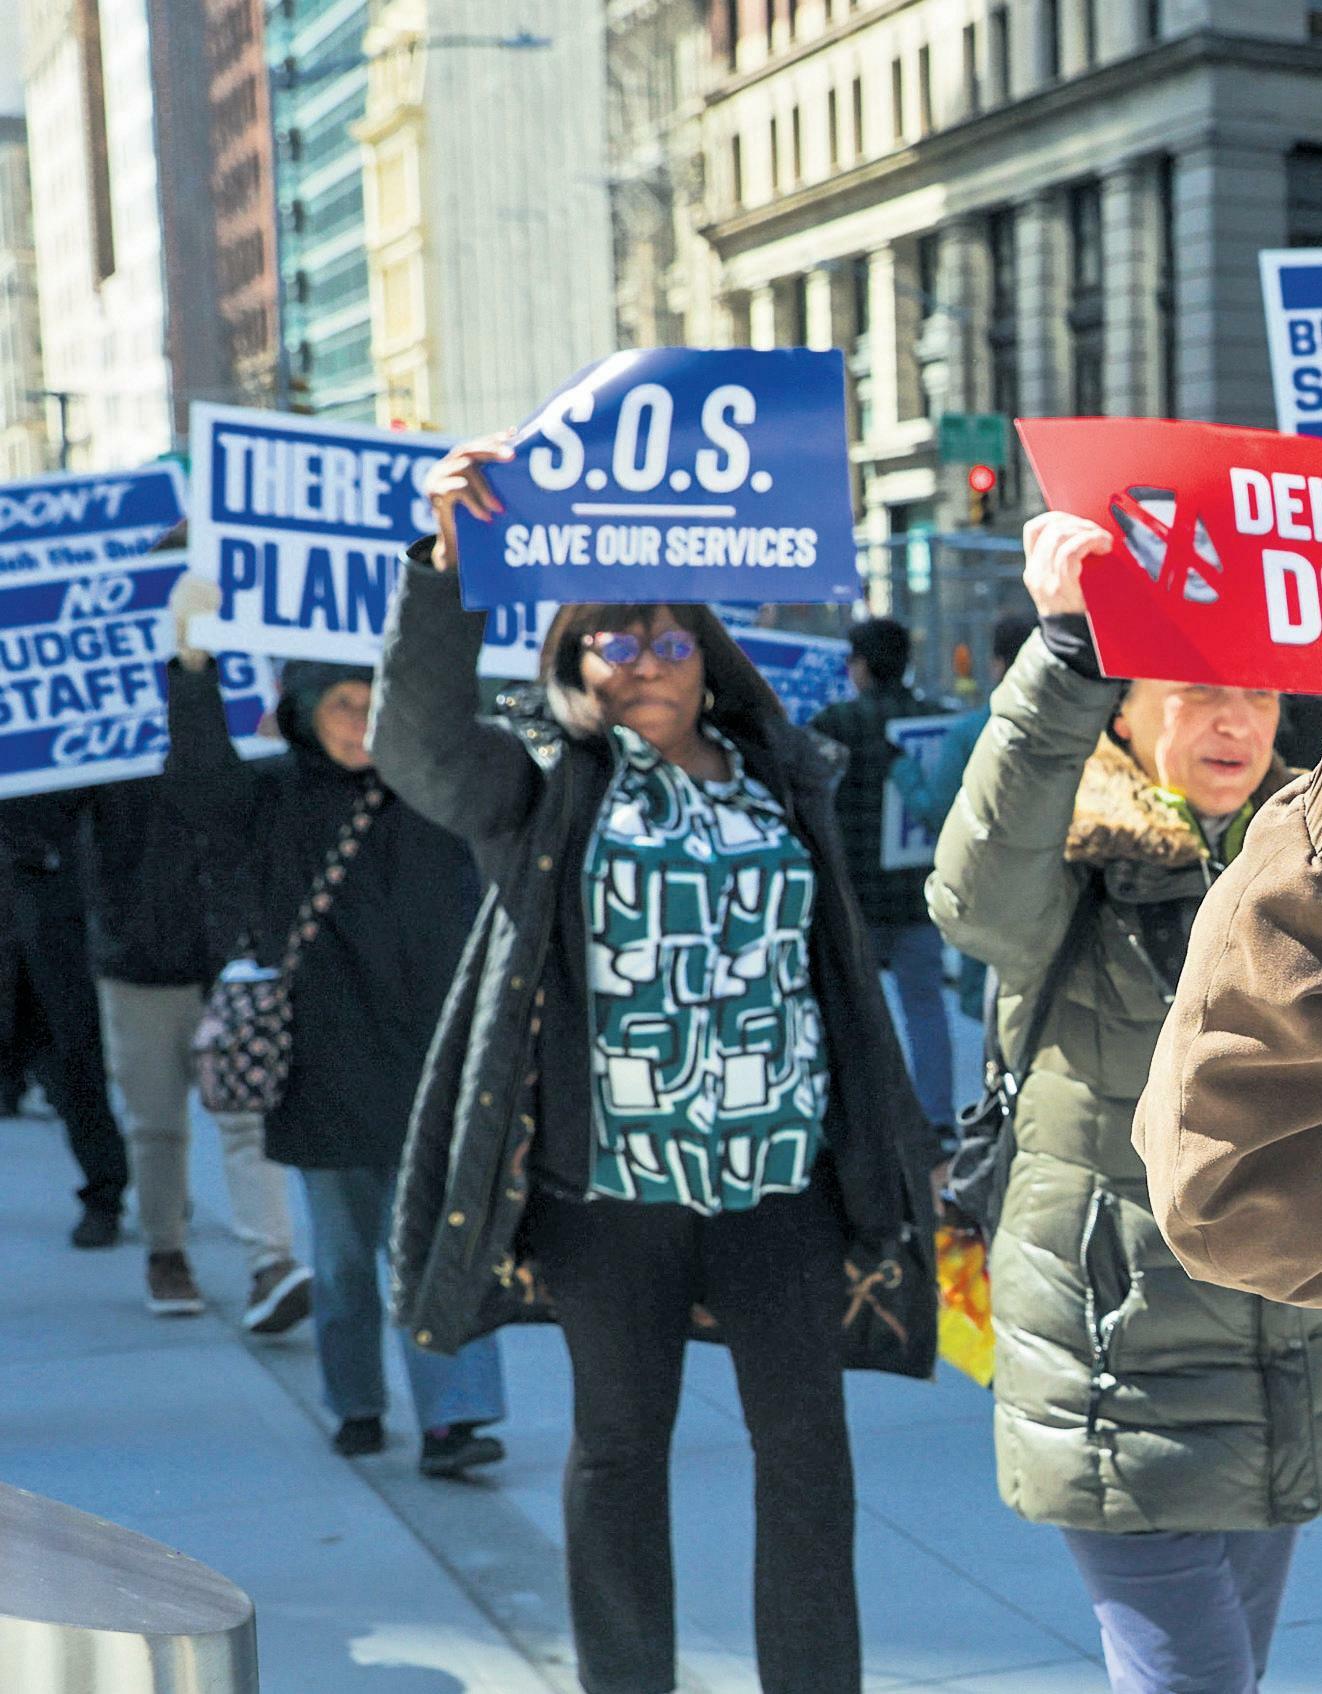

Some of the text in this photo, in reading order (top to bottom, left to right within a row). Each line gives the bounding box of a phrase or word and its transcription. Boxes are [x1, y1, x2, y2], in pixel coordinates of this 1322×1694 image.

[527, 383, 773, 494] S.O.S.
[504, 523, 819, 569] SAVE OUR SERVICES
[58, 574, 134, 622] NO
[0, 616, 158, 673] UDGET
